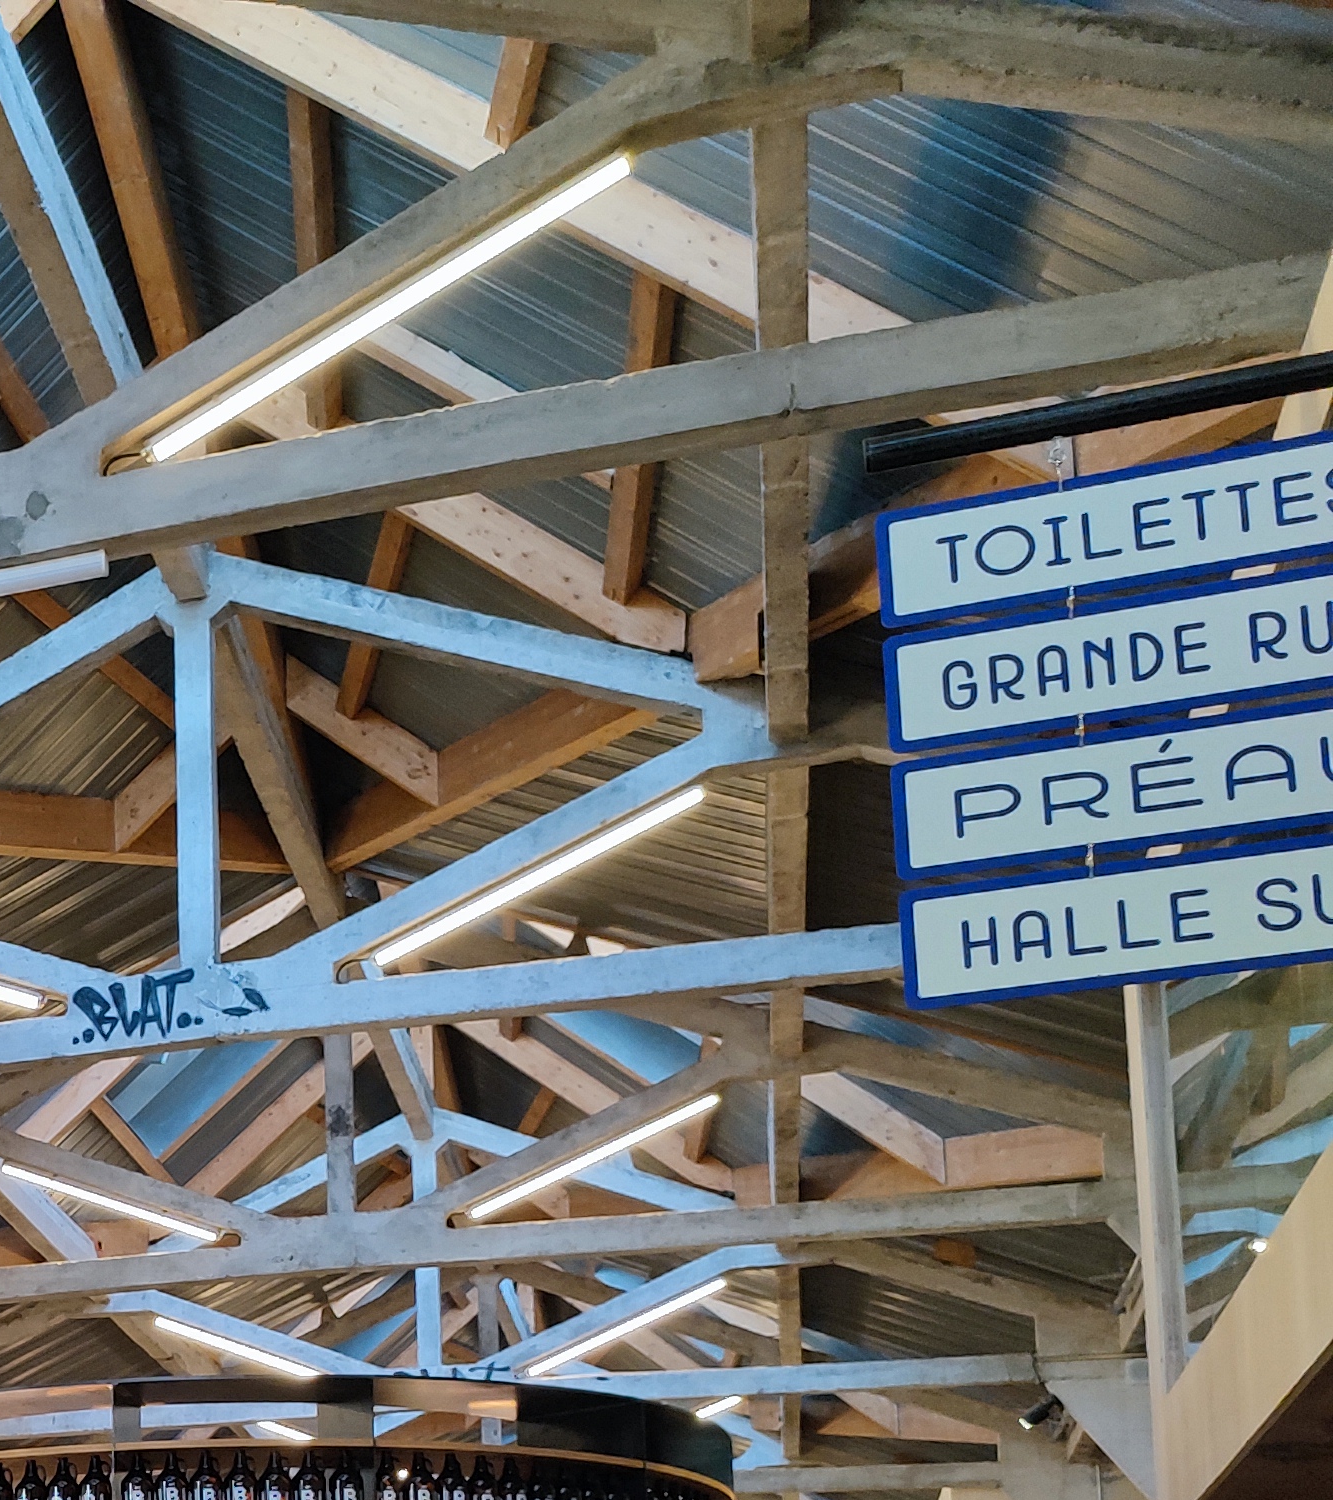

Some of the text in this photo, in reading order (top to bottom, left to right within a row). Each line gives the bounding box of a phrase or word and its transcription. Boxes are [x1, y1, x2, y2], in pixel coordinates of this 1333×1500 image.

[935, 467, 1333, 584] TOILETTE
[942, 621, 1211, 711] GRANDE
[954, 736, 1333, 839] PRÉA
[961, 887, 1215, 970] HALLE
